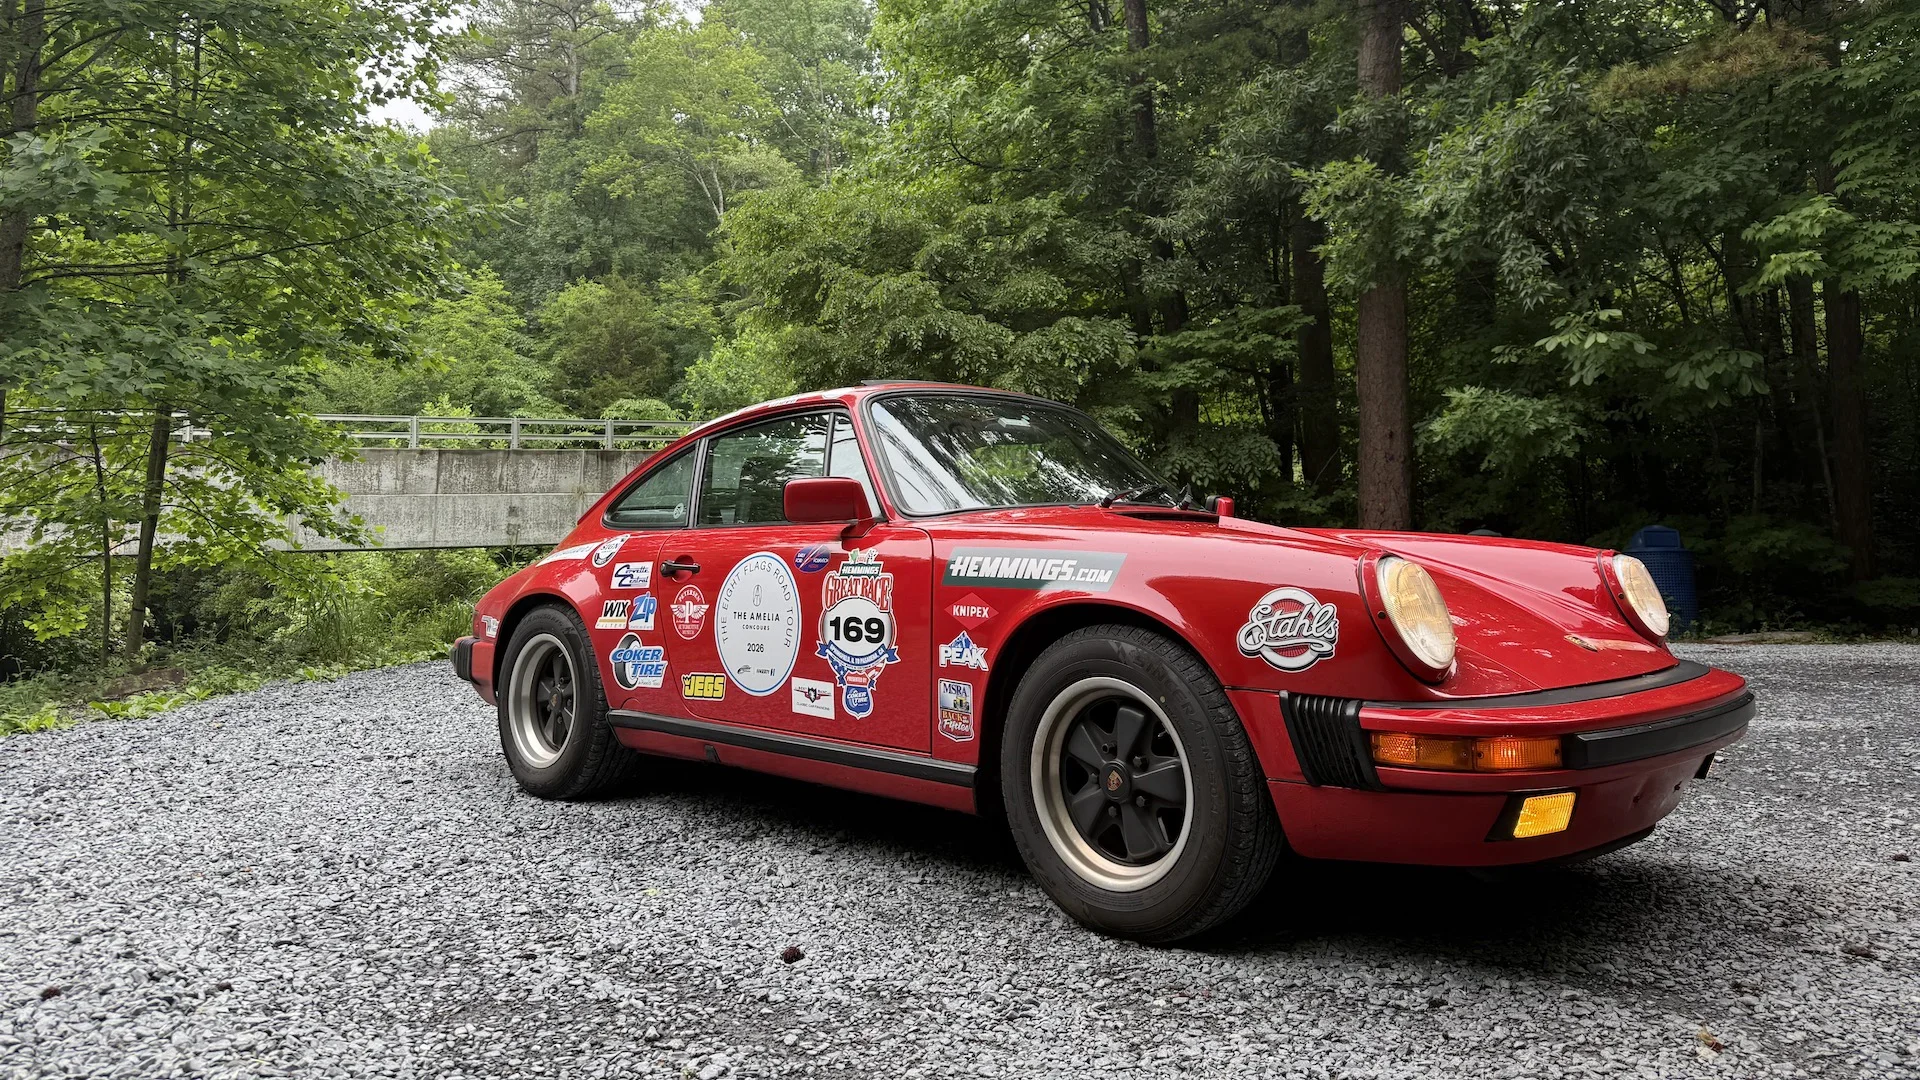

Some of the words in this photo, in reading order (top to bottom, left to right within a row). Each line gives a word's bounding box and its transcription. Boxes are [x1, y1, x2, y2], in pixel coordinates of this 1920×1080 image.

[743, 561, 773, 576] FLAGS
[842, 566, 879, 575] HEMMINGS
[950, 556, 1113, 583] HEMMINGS.COM
[721, 573, 741, 610] EIGHT
[773, 568, 791, 602] ROAD
[825, 575, 860, 609] GREAT
[861, 577, 890, 611] RACE
[603, 601, 629, 617] WIX
[733, 611, 747, 620] THE
[750, 612, 780, 621] AMELIA
[952, 605, 989, 618] KNIPEX
[720, 616, 729, 644] THE
[784, 606, 794, 648] TOUR
[829, 616, 885, 644] 169
[1239, 603, 1338, 652] Stahls
[611, 649, 662, 662] COKER
[747, 643, 764, 653] 2026
[940, 644, 989, 670] PEAK
[631, 663, 664, 676] TIRE
[684, 675, 725, 698] JEGS
[943, 683, 967, 697] MSRA
[942, 711, 963, 722] BACK
